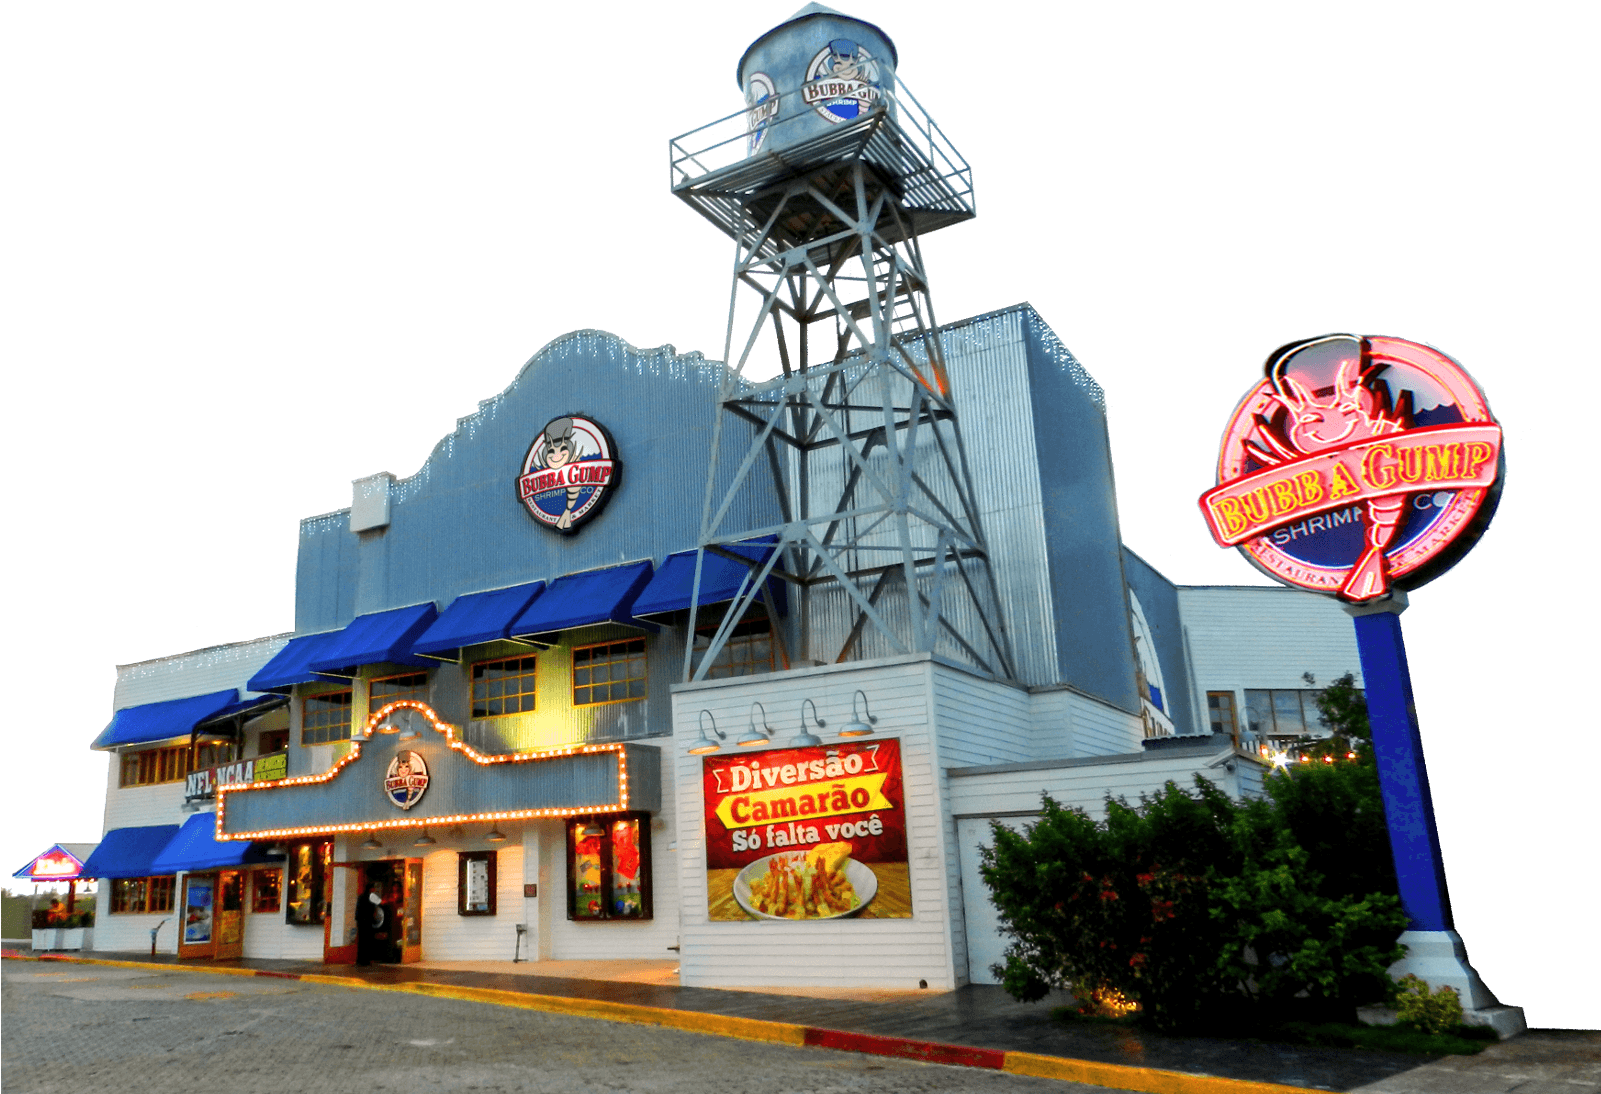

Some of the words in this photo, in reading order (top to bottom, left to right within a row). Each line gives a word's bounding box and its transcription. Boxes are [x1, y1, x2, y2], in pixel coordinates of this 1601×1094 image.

[808, 83, 856, 98] BUBBA
[522, 469, 566, 496] BUBBA
[568, 465, 612, 485] GUMP
[534, 488, 566, 501] SHRIMP
[1212, 462, 1360, 538] BUBBA
[1361, 442, 1492, 490] GUMP
[186, 771, 212, 797] NFL
[216, 760, 254, 786] NCAA
[730, 750, 863, 792] Diversão
[730, 784, 870, 824] Camarão
[732, 828, 761, 852] Só
[766, 822, 820, 847] falta
[825, 814, 883, 840] você
